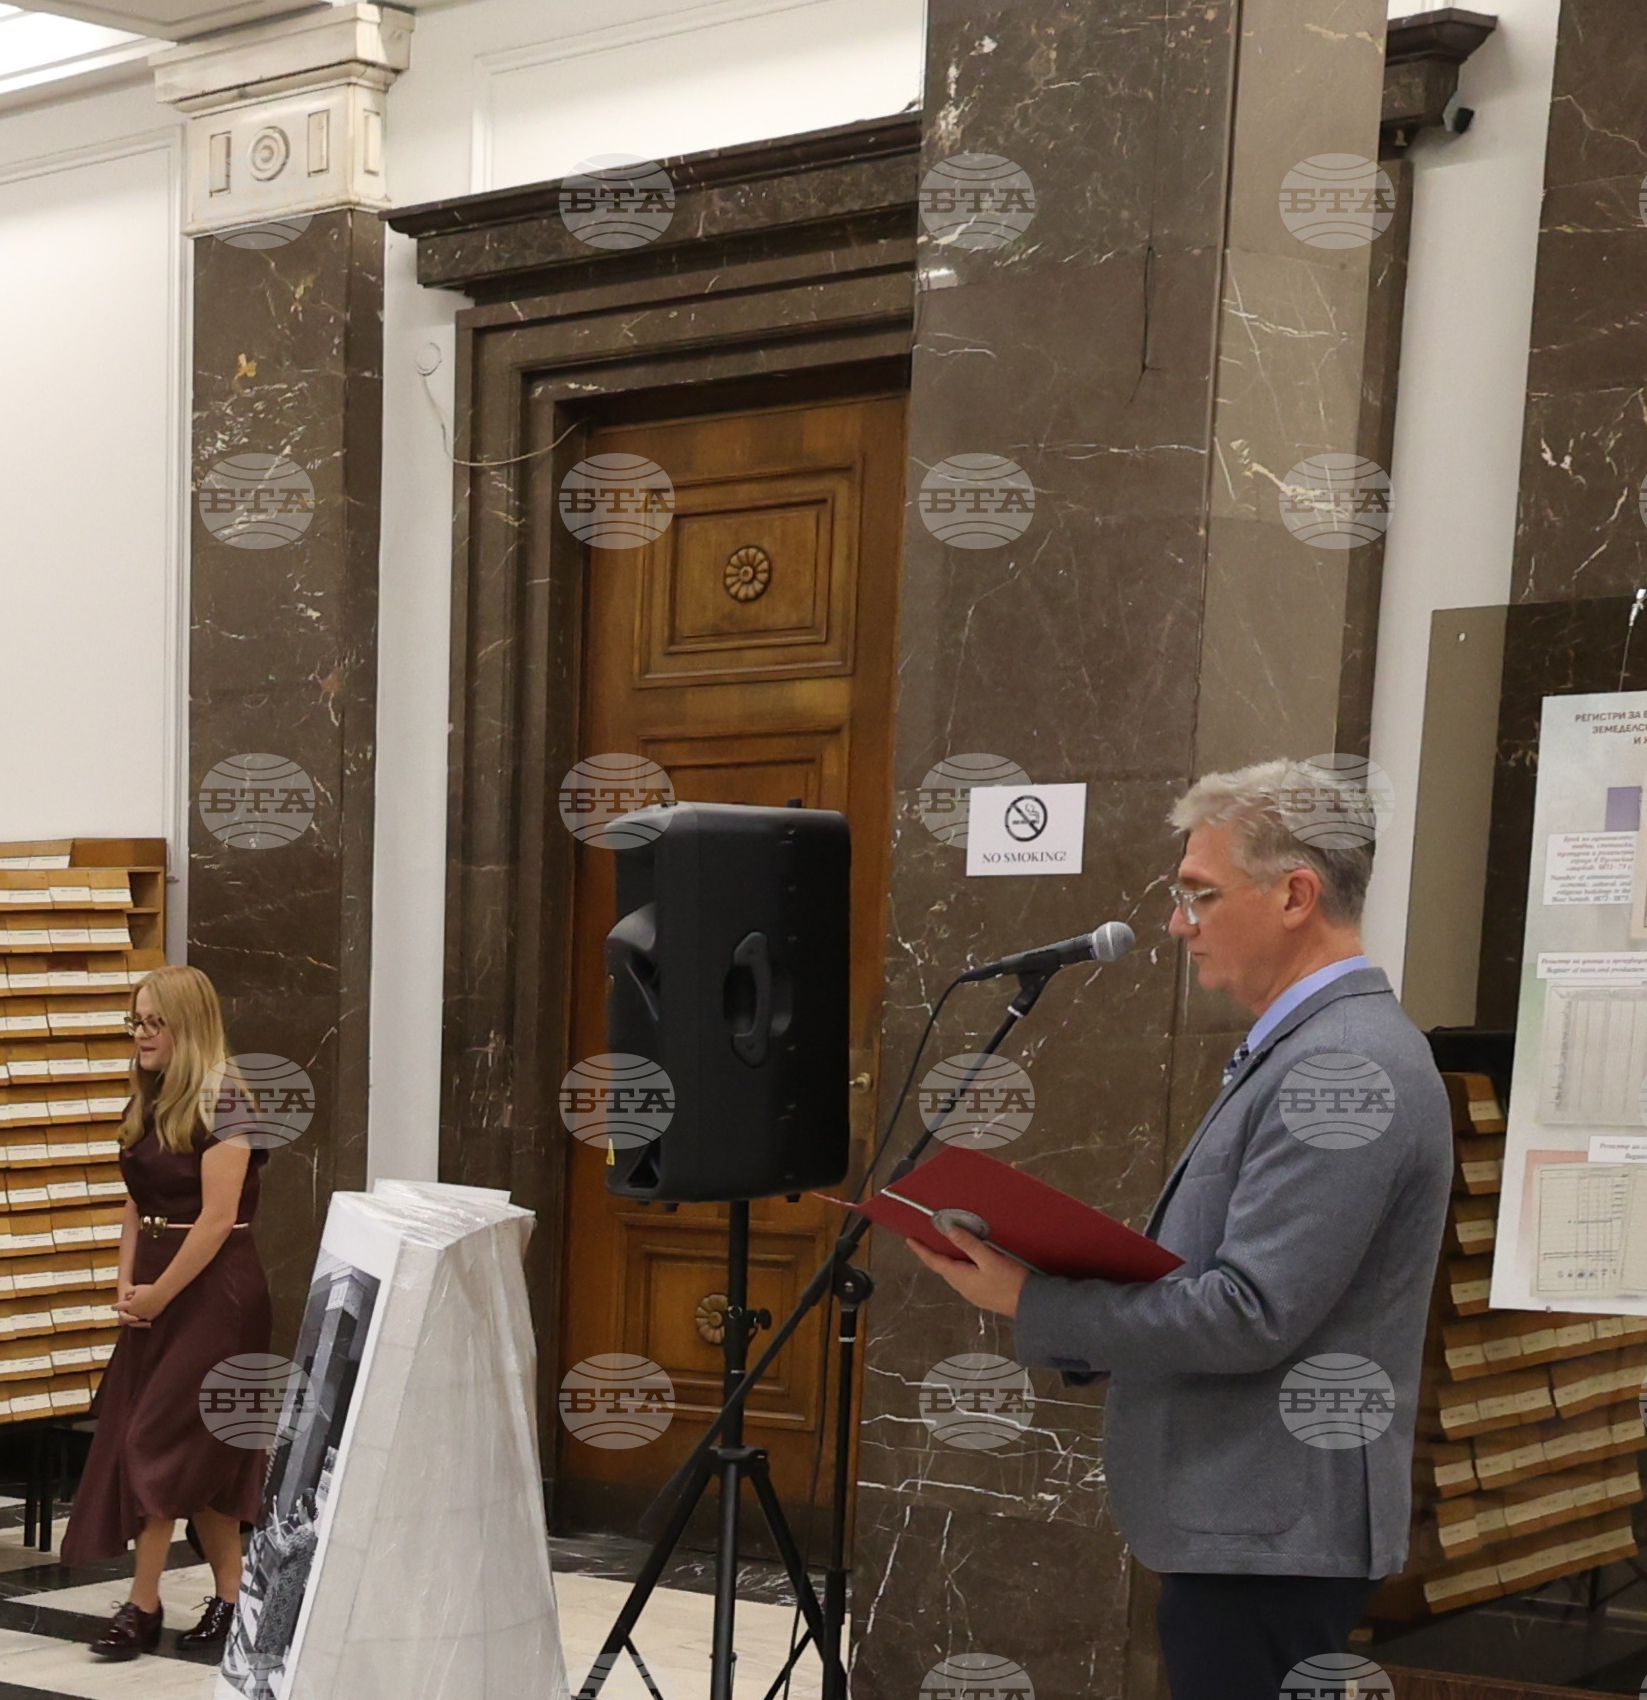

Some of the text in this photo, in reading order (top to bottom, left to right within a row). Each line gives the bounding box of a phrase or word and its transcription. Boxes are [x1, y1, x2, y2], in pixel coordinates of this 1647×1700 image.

[1575, 711, 1626, 722] РЕГИСТРИ
[1628, 710, 1641, 720] ЗА
[1592, 723, 1647, 735] ЗЕМЕДЕЛС
[1634, 736, 1642, 745] И
[982, 850, 1068, 864] NO SMOKING!
